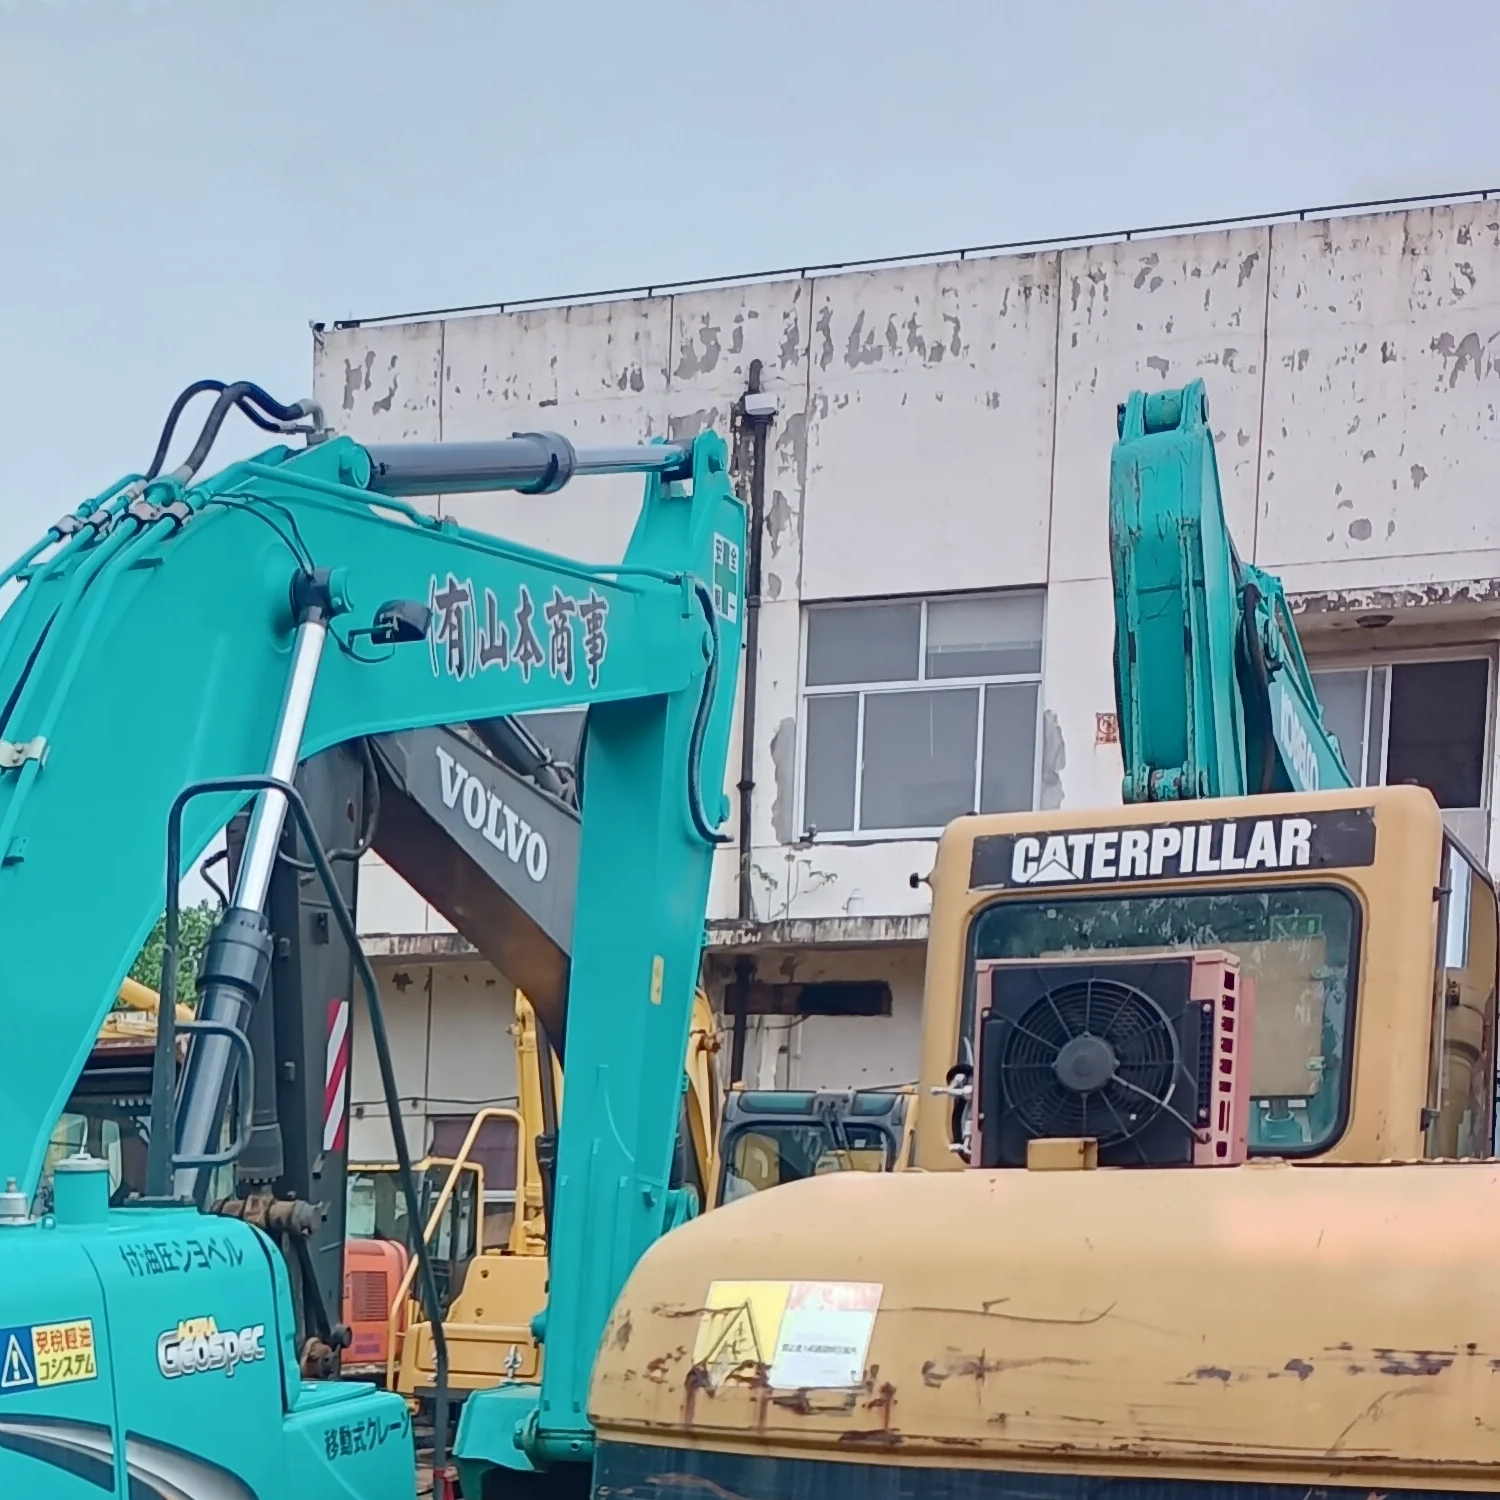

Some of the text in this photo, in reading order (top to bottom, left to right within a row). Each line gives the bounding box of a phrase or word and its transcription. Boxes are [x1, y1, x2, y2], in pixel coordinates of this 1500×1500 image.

[430, 573, 609, 689] (有)山本商事
[436, 746, 547, 882] VOLVO
[1011, 818, 1311, 883] CATERPILLAR
